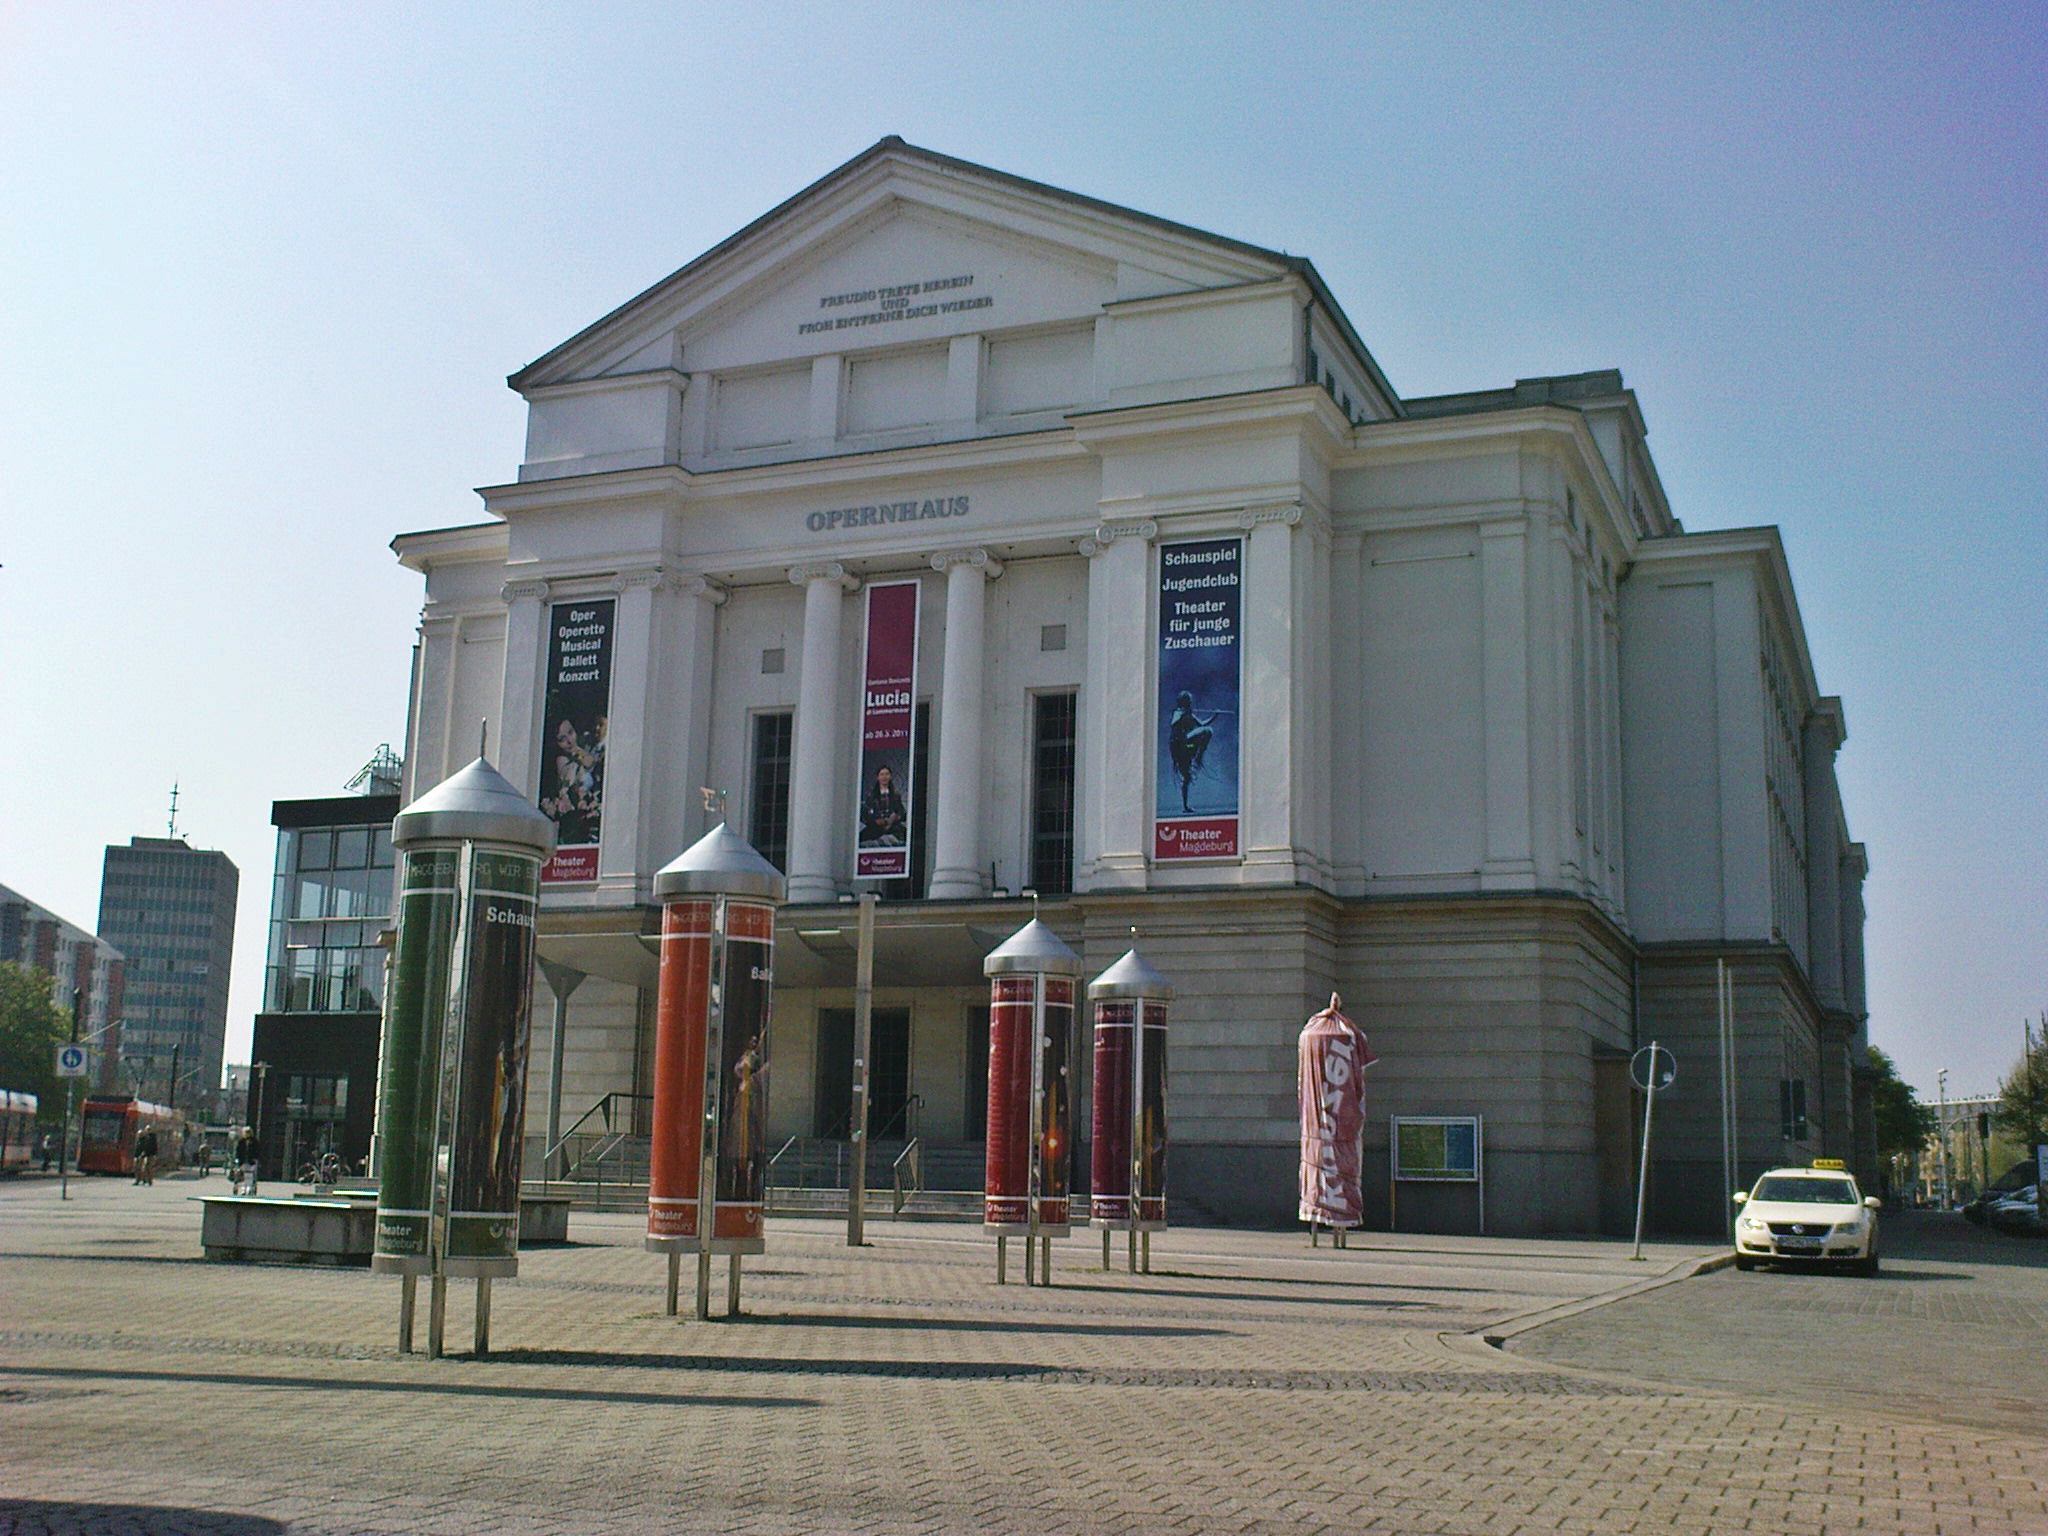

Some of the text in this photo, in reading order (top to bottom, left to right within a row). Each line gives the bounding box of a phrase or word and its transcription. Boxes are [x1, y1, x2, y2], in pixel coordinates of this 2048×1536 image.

[820, 275, 974, 308] FREUDIG TRETE HEREIN
[880, 298, 910, 311] UND
[798, 296, 993, 335] FROH ENTFERNE DICH WIEDER
[806, 496, 970, 532] OPERNHAUS
[1165, 548, 1237, 566] Schauspiel
[1162, 573, 1239, 592] Jugendclub
[1175, 600, 1226, 615] Theater
[570, 610, 596, 623] Oper
[559, 624, 606, 639] Operette
[1169, 617, 1231, 633] für junge
[561, 638, 602, 653] Musical
[1165, 635, 1235, 649] Zuschauer
[563, 654, 598, 668] Ballett
[558, 669, 600, 683] Konzert
[867, 689, 910, 708] Lucia
[1179, 829, 1222, 840] Theater
[1179, 840, 1234, 853] Magdeburg
